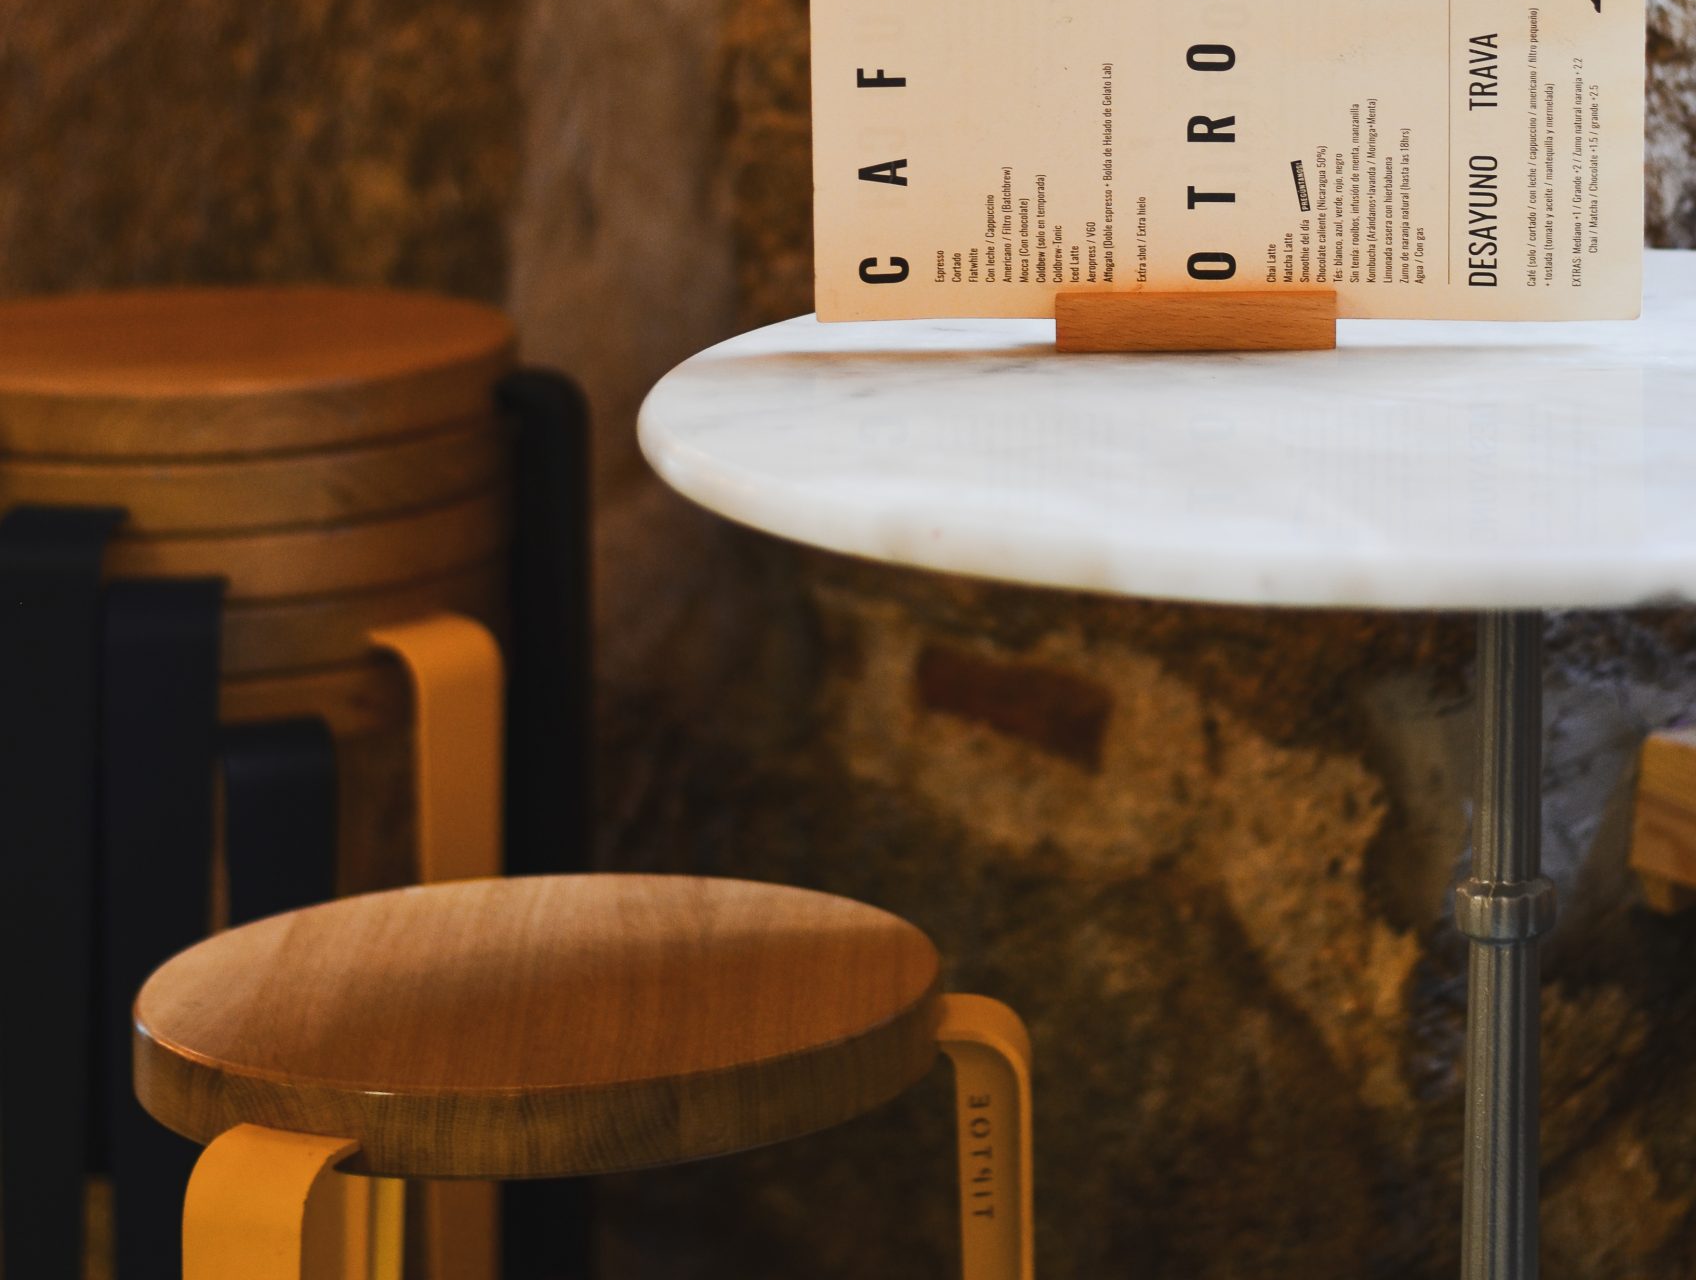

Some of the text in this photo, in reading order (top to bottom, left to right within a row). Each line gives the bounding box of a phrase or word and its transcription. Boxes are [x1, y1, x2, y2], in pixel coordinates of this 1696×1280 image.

[1527, 44, 1537, 63] filtro
[1573, 57, 1583, 69] 2.2
[1101, 81, 1112, 106] Gelato
[1529, 70, 1537, 110] americano
[1575, 77, 1584, 105] naranja
[1102, 108, 1112, 118] de
[1349, 103, 1360, 144] manzanilla
[1573, 107, 1582, 135] natural
[1589, 103, 1601, 129] grande
[1102, 119, 1113, 146] Helado
[1529, 117, 1539, 160] cappuccino
[1572, 136, 1582, 157] Zumo
[1102, 147, 1113, 157] de
[1335, 153, 1345, 175] negro
[1399, 153, 1410, 165] las
[1468, 33, 1498, 287] DESAYUNO TRAVA
[1544, 136, 1555, 180] mantequilla
[1349, 173, 1360, 183] de
[1527, 168, 1537, 188] leche
[1588, 154, 1598, 192] Chocolate
[1529, 190, 1537, 204] con
[1544, 188, 1553, 212] aceite
[1572, 176, 1582, 203] Grande
[1104, 189, 1115, 223] espresso
[1383, 156, 1393, 284] Limonada casera con hierbabuena
[1399, 192, 1410, 220] natural
[1588, 200, 1598, 228] Matcha
[984, 194, 997, 283] Con leche Cappuccino
[1001, 215, 1012, 235] Filtro
[1037, 219, 1046, 229] en
[1316, 212, 1327, 243] caliente
[1401, 221, 1411, 250] naranja
[1527, 211, 1537, 242] cortado
[1572, 222, 1582, 254] Mediano
[1052, 225, 1063, 283] Coldbrew-Tonic
[1085, 221, 1099, 283] Aeropress V60
[1136, 196, 1147, 283] Extra shot Extra hielo
[1299, 219, 1310, 283] Smoothie del día
[1588, 236, 1598, 254] Chai
[934, 250, 947, 283] Espresso
[951, 252, 962, 283] Cortado
[968, 248, 979, 283] Flatwhite
[1002, 243, 1012, 283] Americano
[1019, 258, 1029, 283] Mocca
[1069, 245, 1080, 283] Iced Latte
[1103, 250, 1115, 283] Affogato
[1266, 243, 1277, 283] Chai Latte
[1283, 232, 1293, 283] Matcha Latte
[1316, 245, 1327, 283] Chocolate
[1366, 243, 1376, 283] Kombucha
[1399, 251, 1410, 262] de
[1413, 227, 1426, 285] Agua Con gas
[1543, 252, 1553, 281] tostada
[1349, 270, 1360, 283] Sin
[1399, 263, 1410, 284] Zumo
[1526, 269, 1537, 287] Café
